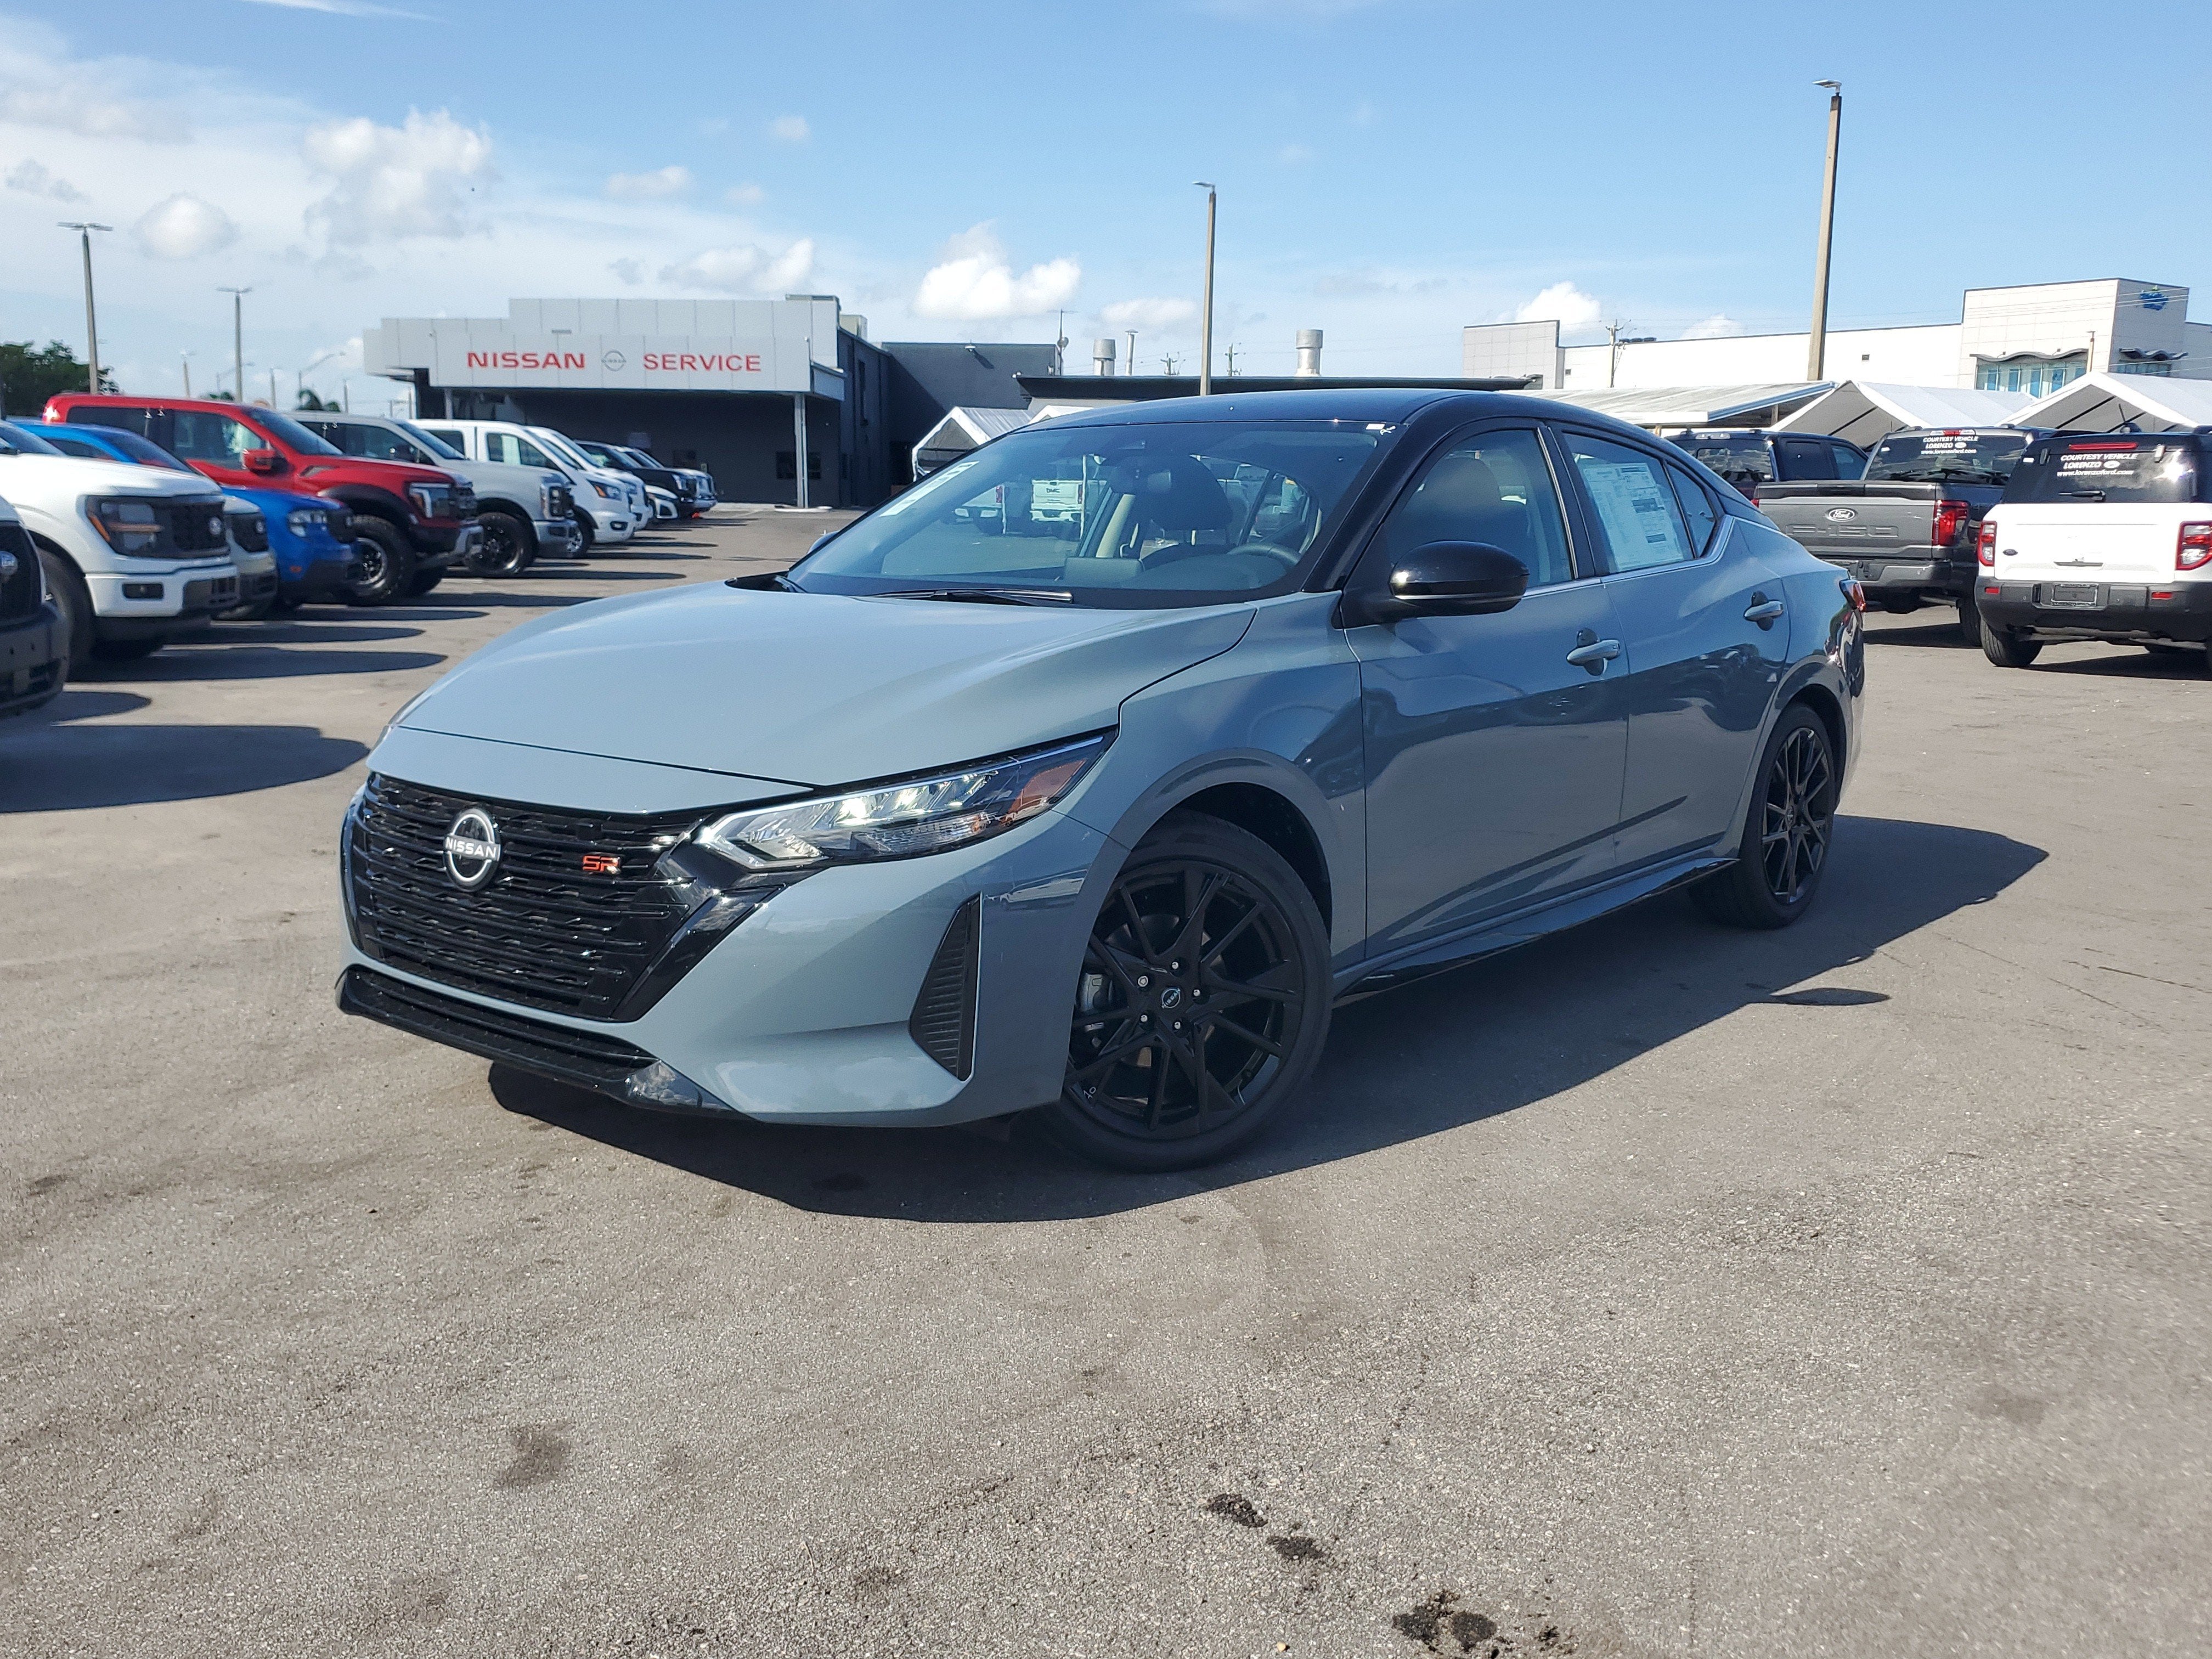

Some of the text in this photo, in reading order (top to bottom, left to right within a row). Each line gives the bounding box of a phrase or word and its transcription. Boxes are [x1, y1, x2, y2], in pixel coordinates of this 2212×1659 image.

[467, 352, 761, 371] NISSAN SERVICE
[1832, 510, 1850, 519] Ford
[1785, 524, 1899, 538] F-150
[445, 836, 496, 857] NISSAN
[583, 855, 620, 874] SR
